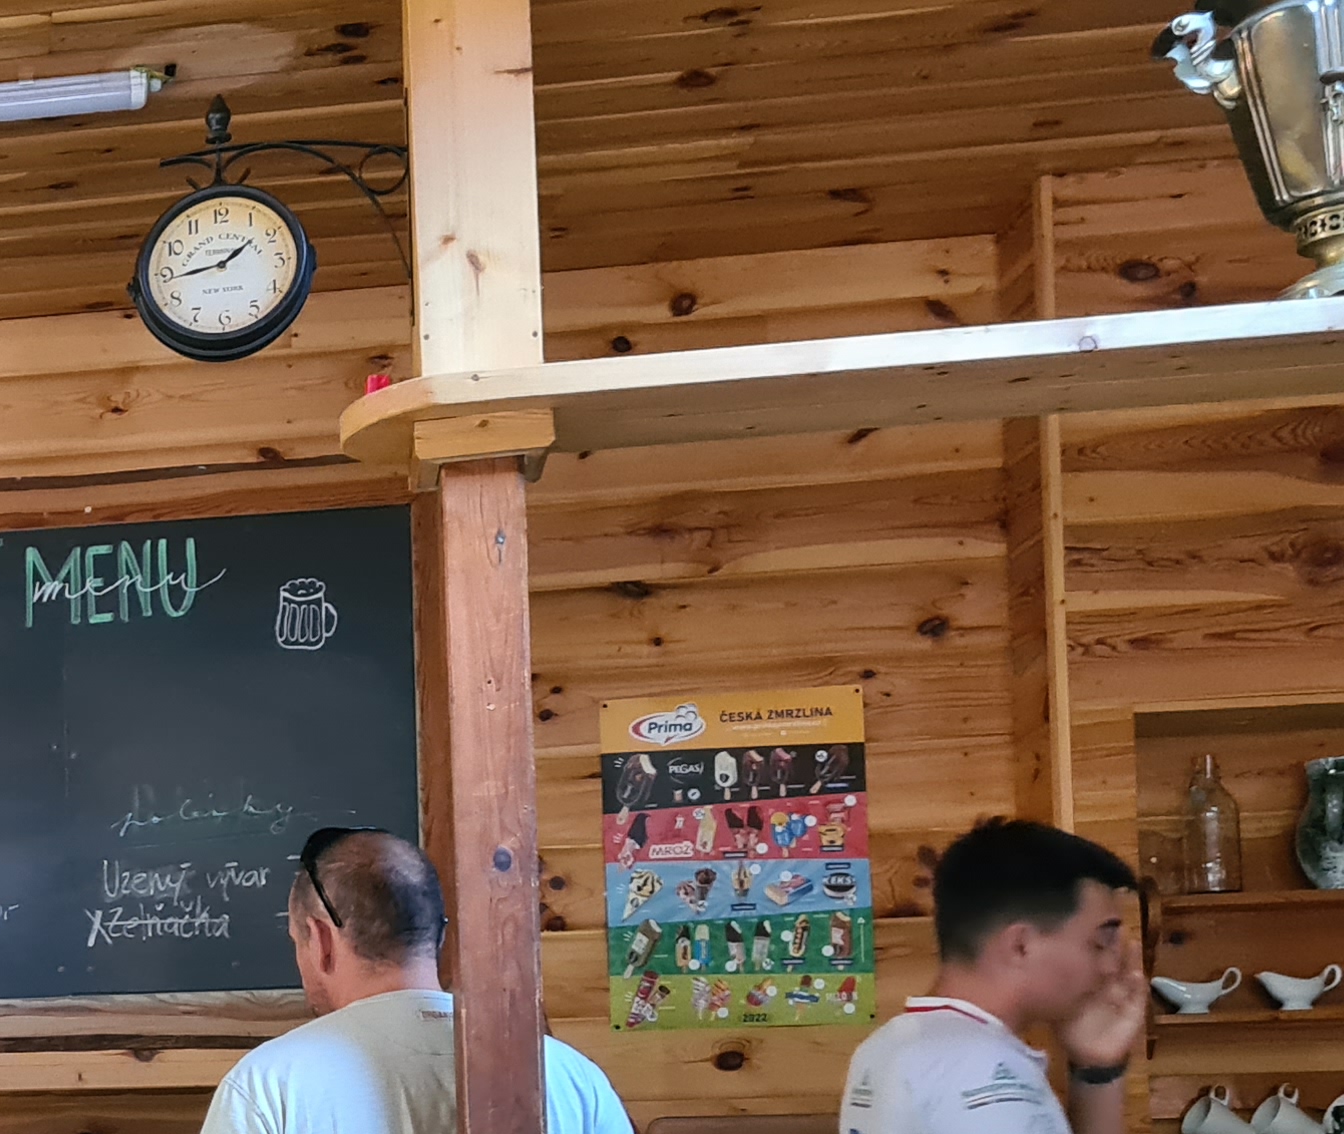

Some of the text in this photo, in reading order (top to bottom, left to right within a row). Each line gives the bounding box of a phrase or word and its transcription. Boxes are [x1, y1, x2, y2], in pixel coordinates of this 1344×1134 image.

[213, 207, 229, 224] 12
[248, 211, 253, 227] 1
[187, 219, 199, 235] 11
[265, 228, 277, 244] 2
[167, 239, 184, 257] 10
[182, 236, 214, 267] GRAND
[274, 252, 286, 268] 3
[159, 266, 174, 283] 9
[266, 279, 280, 294] 4
[170, 290, 182, 307] 8
[191, 307, 202, 324] 7
[218, 309, 231, 326] 6
[248, 300, 260, 318] 5
[25, 536, 197, 628] MENU
[767, 706, 833, 721] ZMRZLINA
[648, 720, 693, 734] Prima
[668, 764, 700, 774] PEGAS
